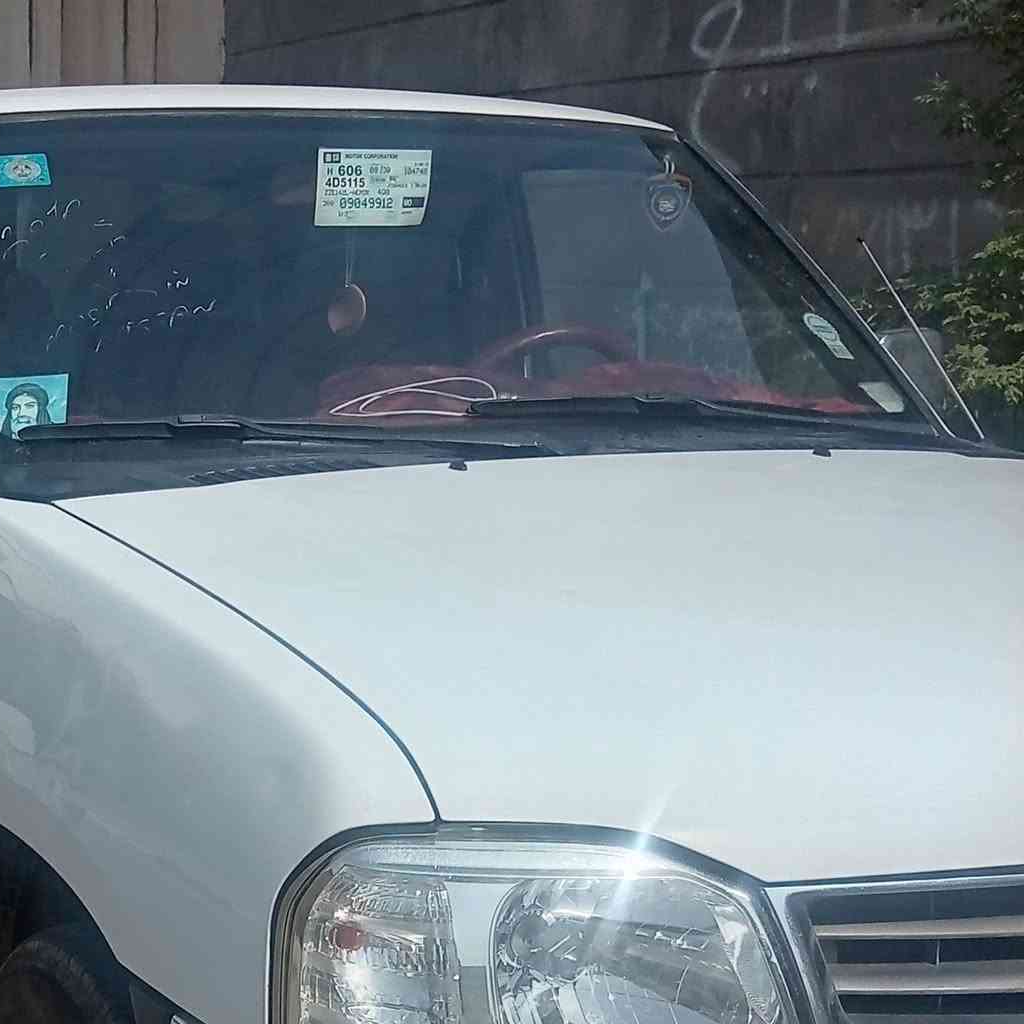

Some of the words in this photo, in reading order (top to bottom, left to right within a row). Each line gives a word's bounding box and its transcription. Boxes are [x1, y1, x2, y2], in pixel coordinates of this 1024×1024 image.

[338, 165, 362, 176] 606
[325, 177, 366, 188] 4D5115
[339, 197, 393, 209] 09049912
